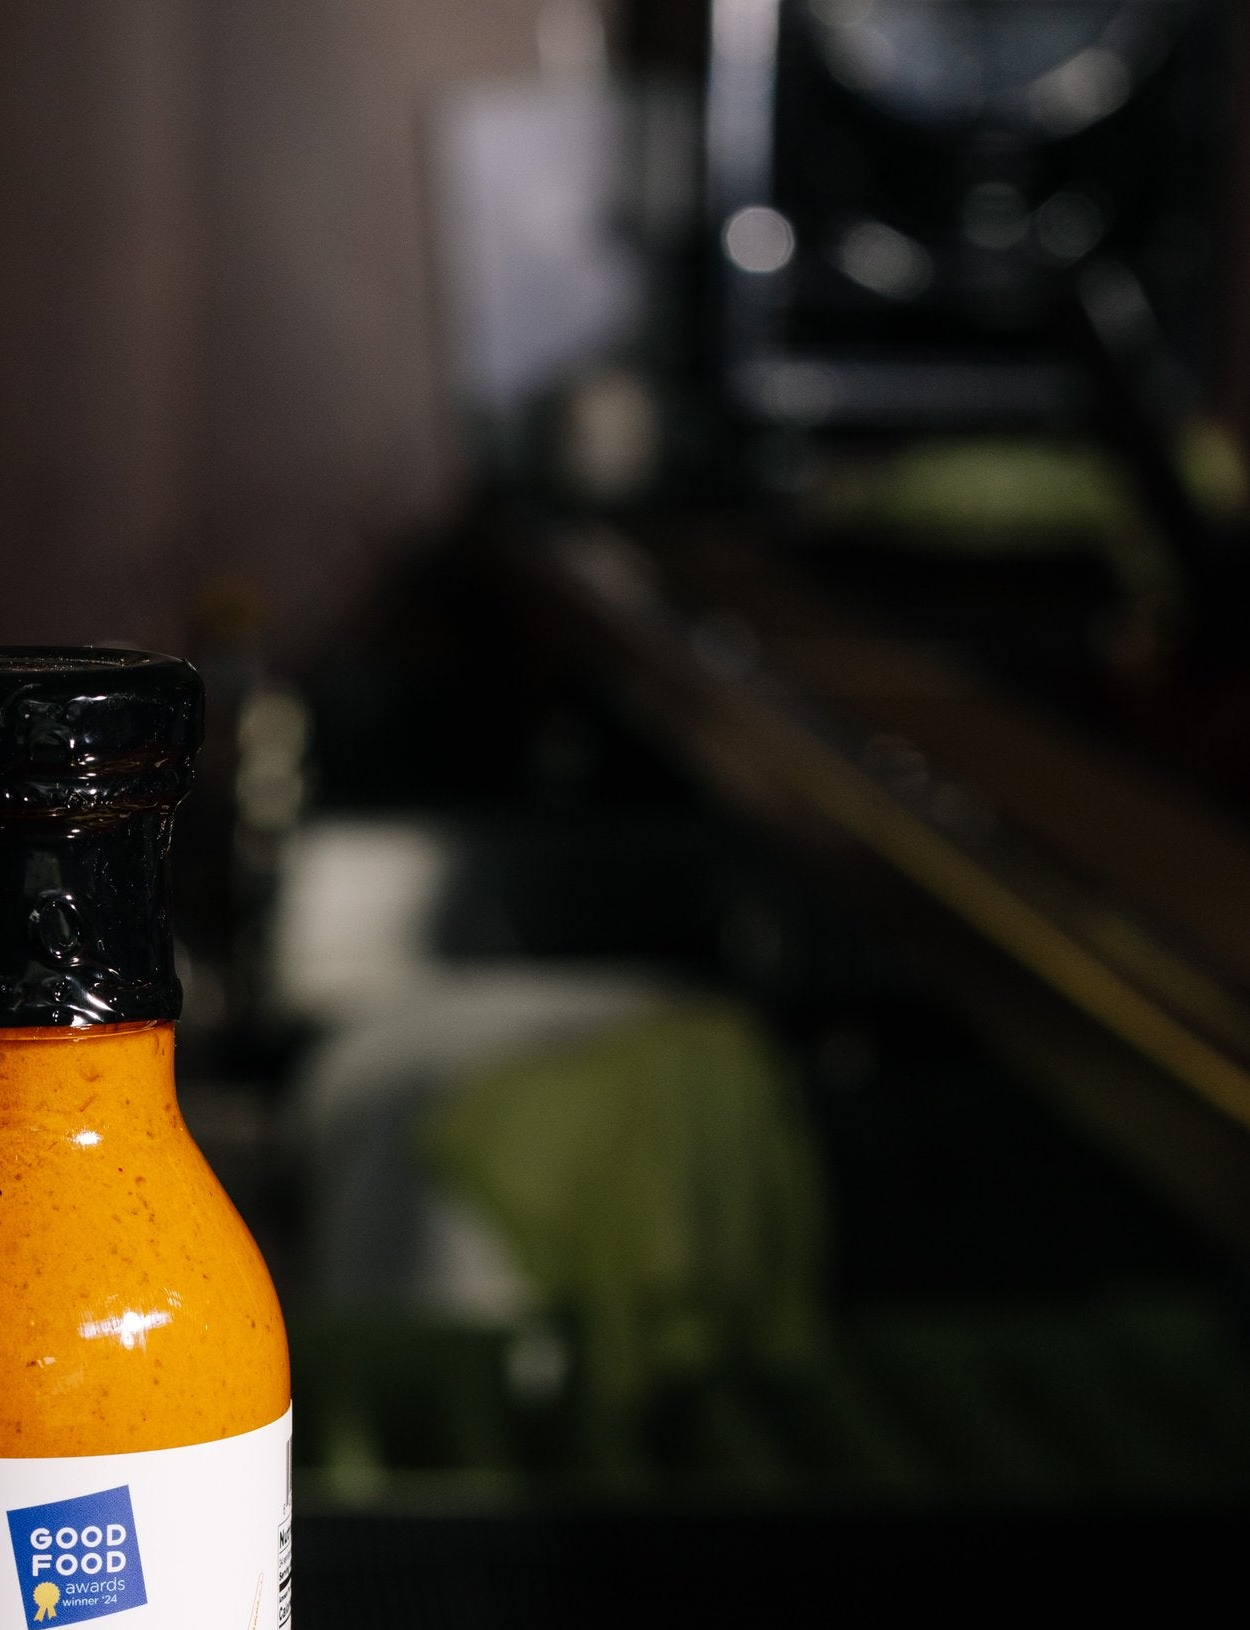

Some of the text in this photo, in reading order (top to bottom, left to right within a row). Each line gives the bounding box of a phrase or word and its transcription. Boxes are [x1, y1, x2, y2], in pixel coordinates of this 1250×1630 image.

[30, 1524, 127, 1550] GOOD
[31, 1551, 127, 1577] FOOD
[65, 1576, 126, 1594] awards
[62, 1596, 100, 1607] winner
